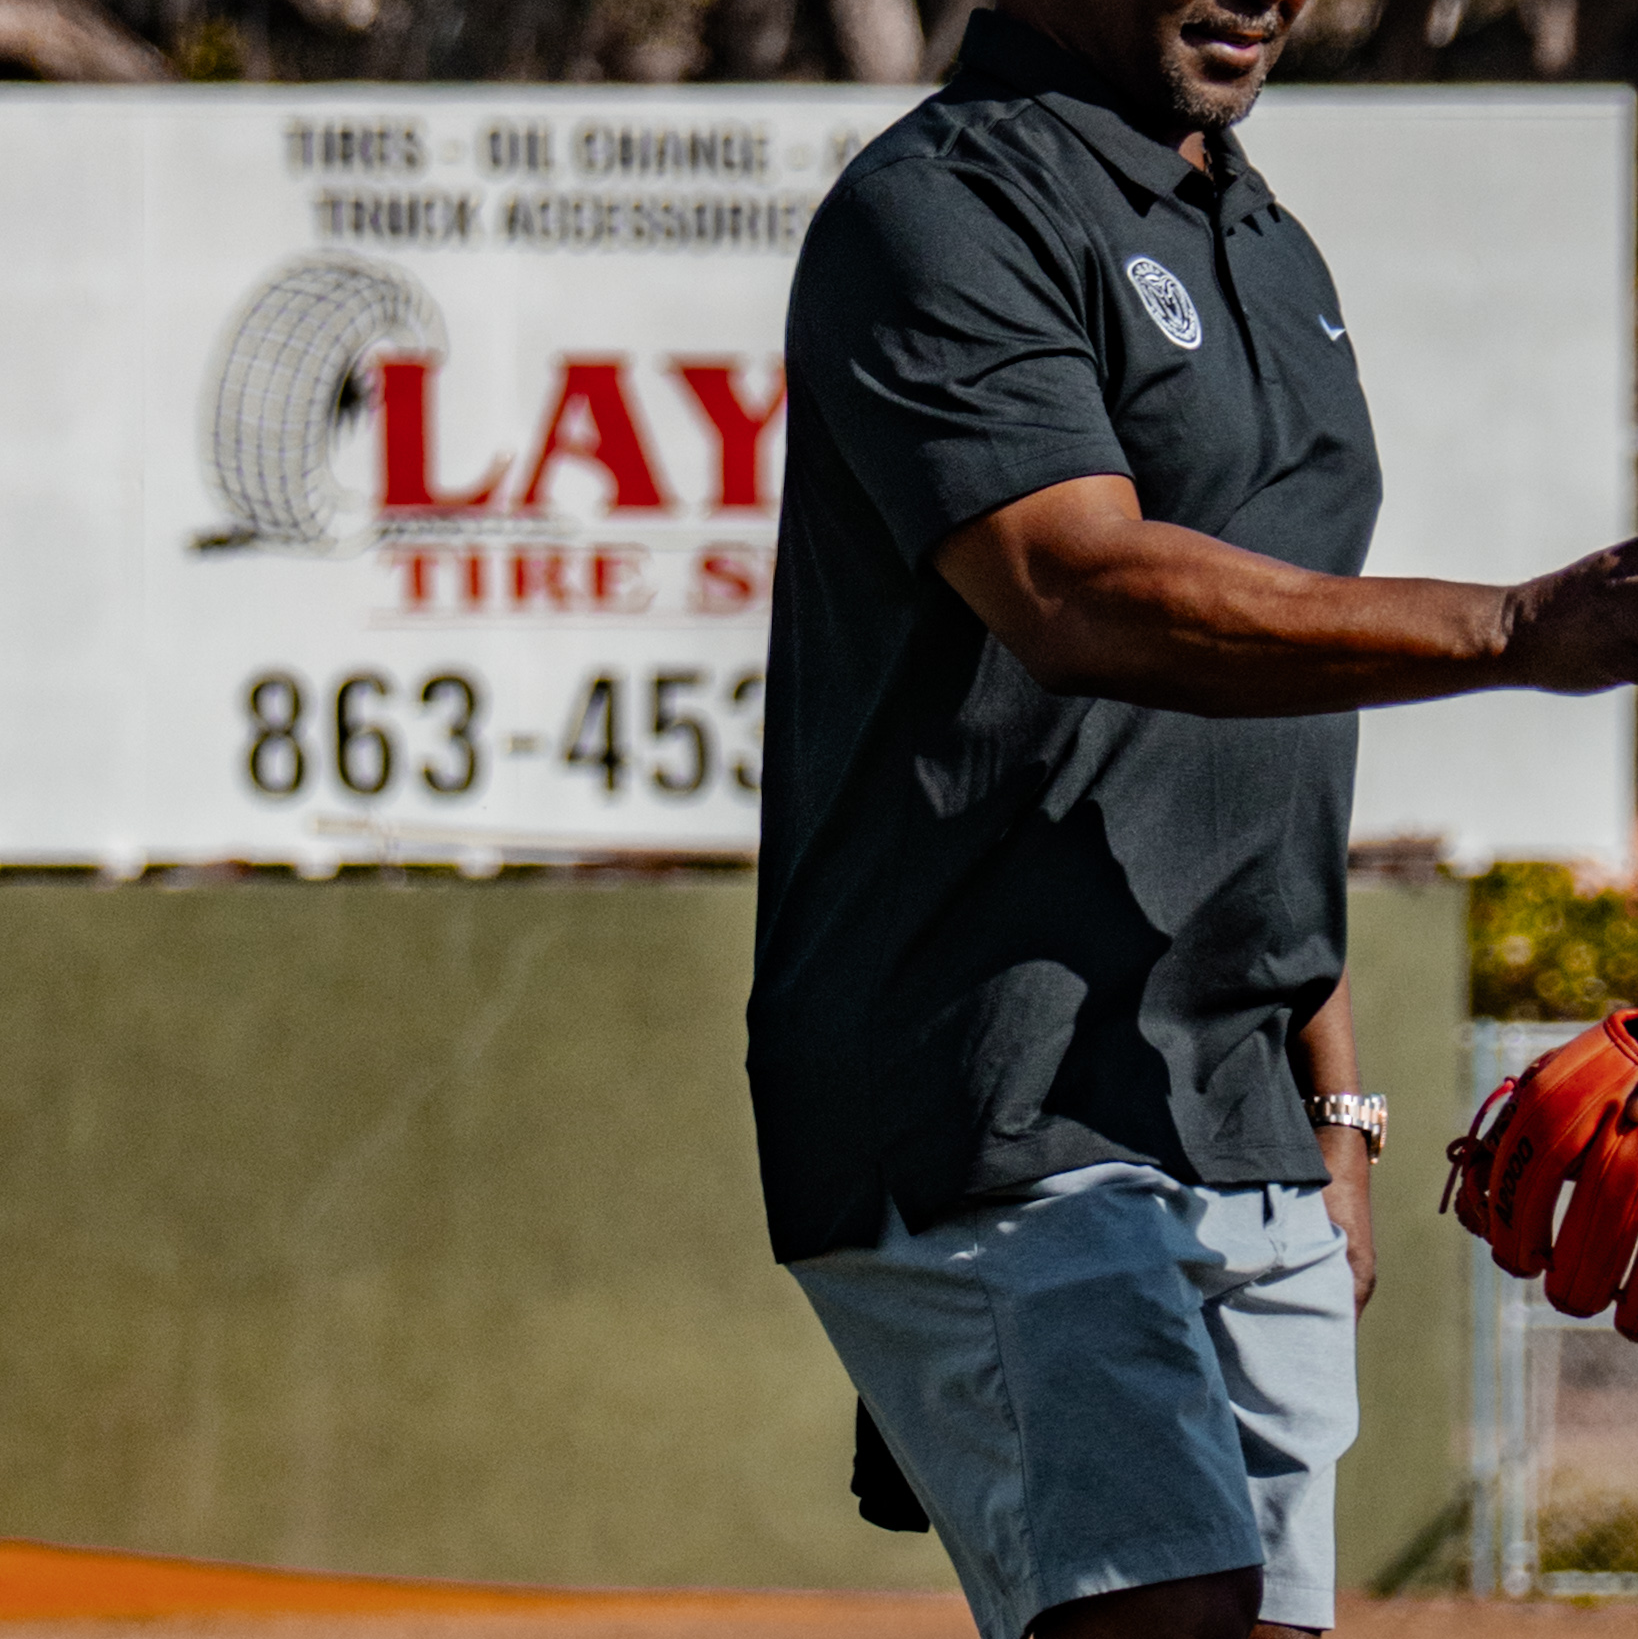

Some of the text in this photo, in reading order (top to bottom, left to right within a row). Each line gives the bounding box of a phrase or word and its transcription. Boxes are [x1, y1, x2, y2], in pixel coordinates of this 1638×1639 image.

[283, 120, 427, 176] TIRES
[480, 120, 554, 178] OIL
[572, 122, 770, 178] CHANGE
[311, 191, 478, 244] TRUCK
[368, 354, 788, 517] LAY
[379, 542, 655, 614] TIRE
[1494, 1135, 1534, 1230] A2000
